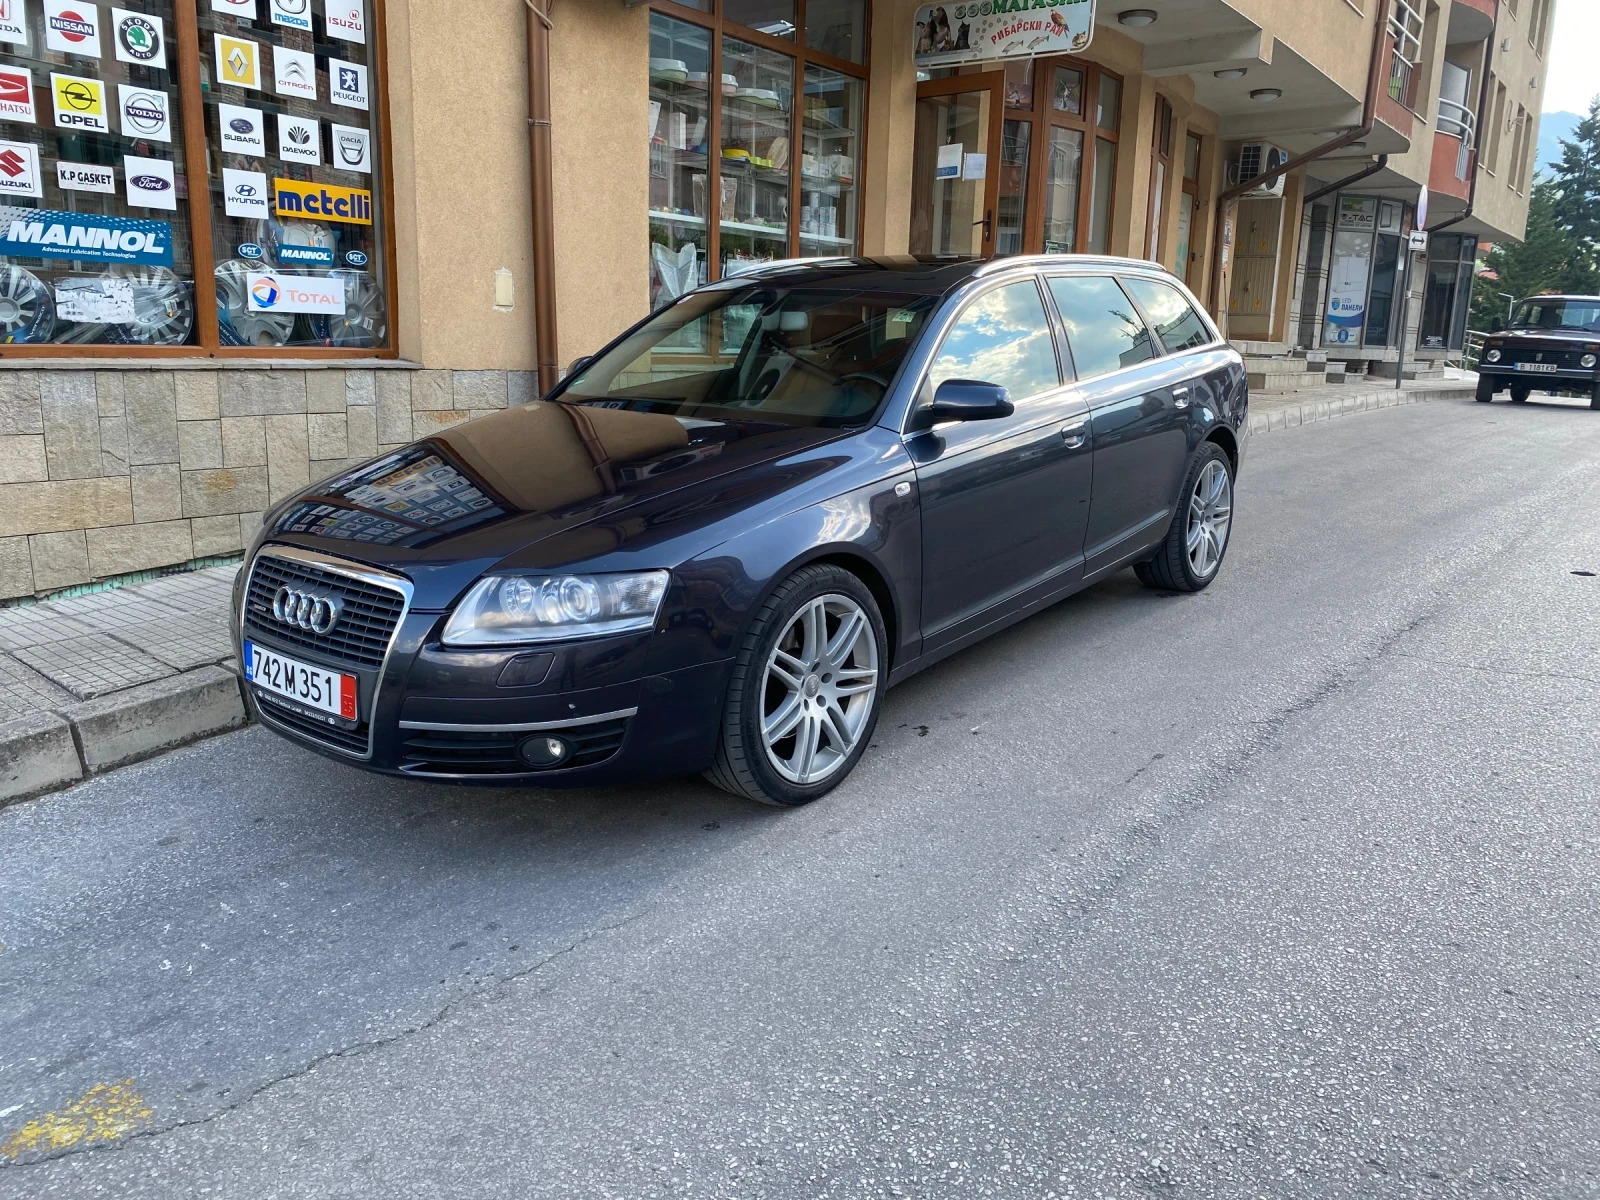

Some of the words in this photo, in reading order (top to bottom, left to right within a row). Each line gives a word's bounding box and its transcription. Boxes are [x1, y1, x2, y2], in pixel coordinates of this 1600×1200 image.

[51, 18, 94, 36] NISSAN
[328, 16, 363, 31] ISUZU
[991, 20, 1042, 45] РИБАРСКИ
[129, 48, 153, 58] AUTO
[333, 90, 366, 103] PEUGEOT
[127, 107, 163, 120] VOLVO
[59, 113, 105, 129] OPEL
[224, 133, 261, 145] SUBARU
[340, 136, 362, 145] DACIA
[282, 146, 317, 157] DAEWOO
[60, 169, 76, 181] K.P
[77, 172, 112, 185] GASKET
[138, 176, 163, 190] Ford
[0, 180, 32, 189] UZUKI
[227, 196, 265, 206] HYUNDAI
[278, 190, 370, 220] metelli
[1340, 213, 1373, 222] V-TAC
[6, 220, 165, 254] MANNOL
[42, 246, 69, 254] Advanced
[102, 251, 136, 259] Technologies
[241, 246, 257, 254] SCT
[281, 249, 331, 261] MANNOL
[349, 253, 362, 262] SCT
[287, 290, 341, 304] TOTAL
[253, 650, 332, 706] 742M351
